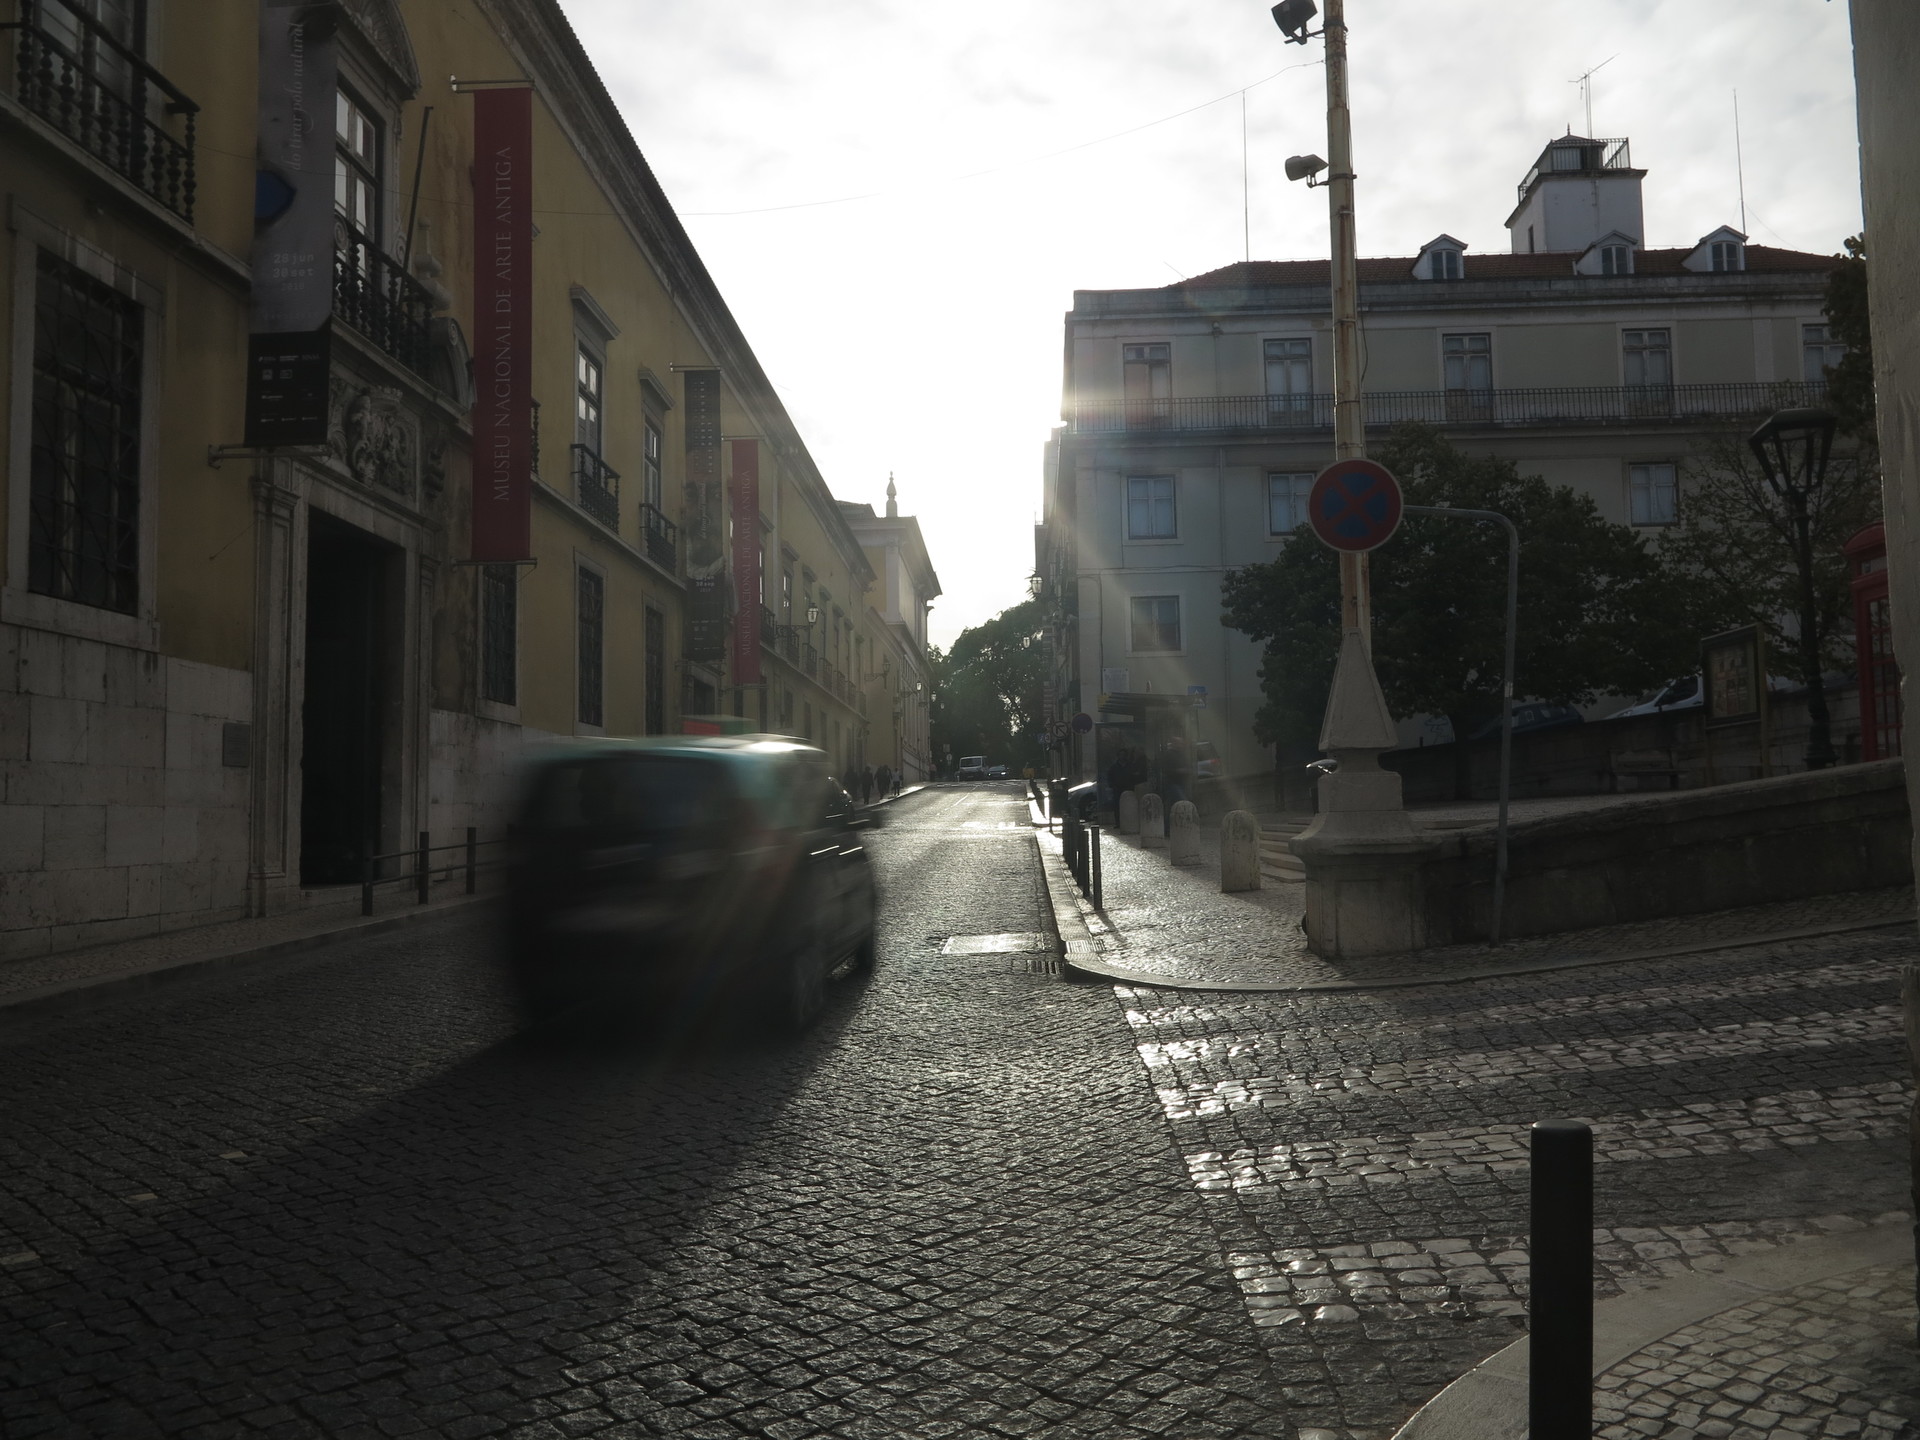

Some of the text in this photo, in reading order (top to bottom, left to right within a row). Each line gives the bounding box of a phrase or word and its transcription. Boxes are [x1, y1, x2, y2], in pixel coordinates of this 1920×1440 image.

[287, 22, 305, 77] natural
[288, 115, 304, 149] tirar
[281, 153, 302, 171] do
[494, 146, 511, 503] MUSEU NACIONAL DE ARTE ANTIGA
[741, 470, 752, 657] MUSEU NACIONAL DE ARTE ANTIGA
